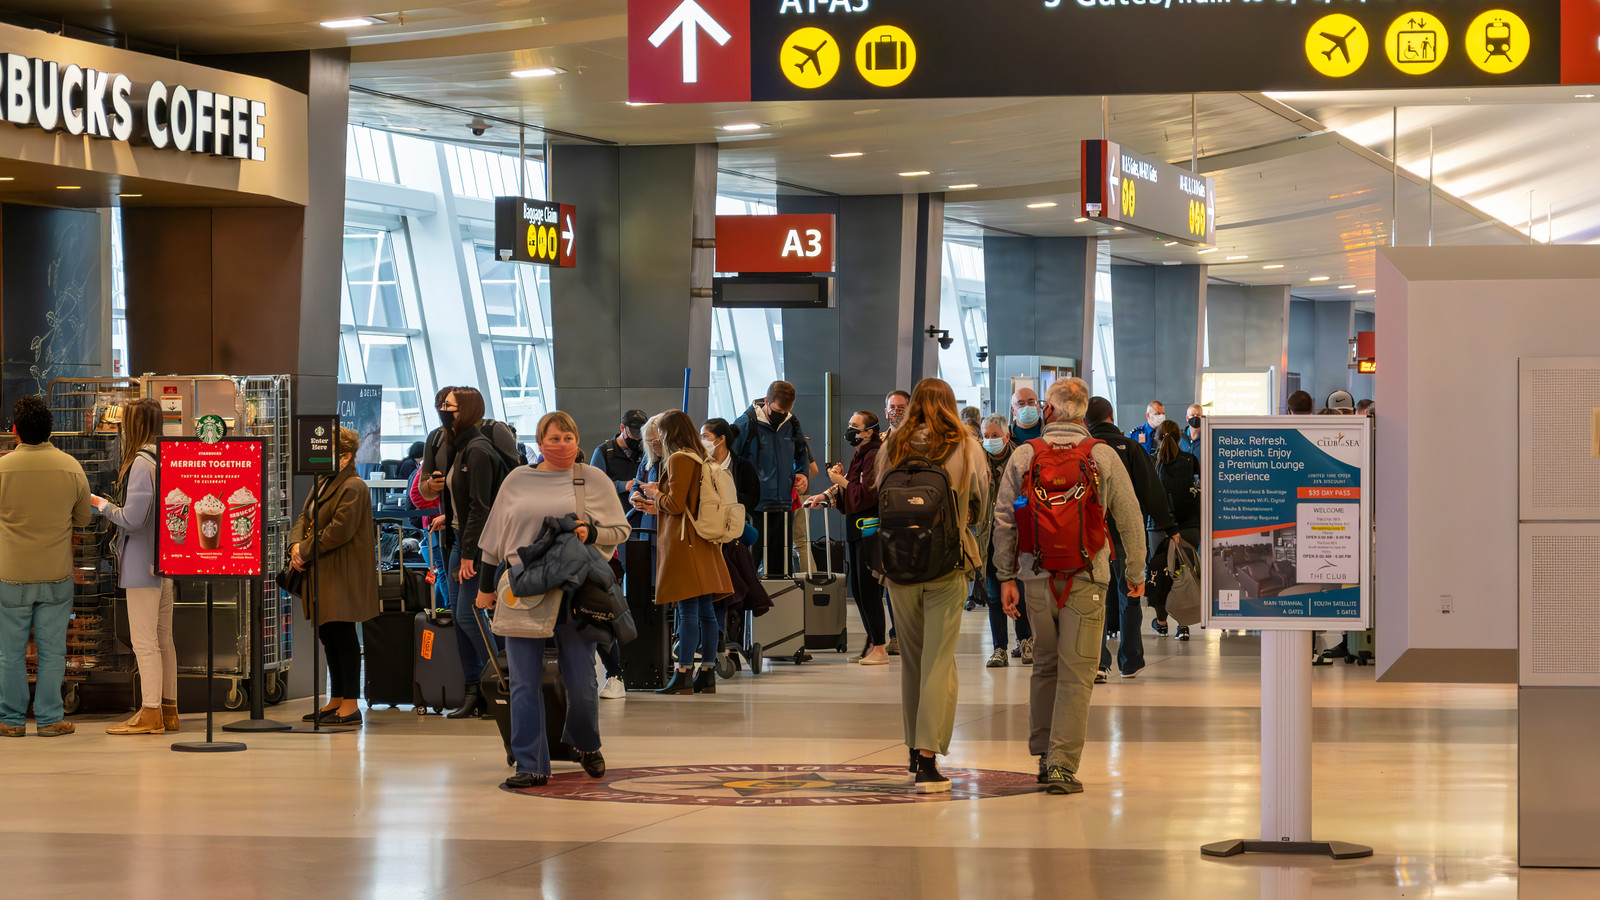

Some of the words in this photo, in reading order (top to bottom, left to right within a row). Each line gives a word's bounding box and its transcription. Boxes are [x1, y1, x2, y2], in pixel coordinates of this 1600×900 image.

[0, 53, 132, 141] BUCKS
[147, 80, 266, 161] COFFEE
[524, 202, 544, 225] Baggage
[544, 206, 558, 224] Claim
[781, 229, 822, 257] A3
[341, 400, 356, 416] CAN
[1218, 436, 1246, 445] Relax.
[1249, 436, 1287, 445] Refresh.
[1218, 448, 1265, 459] Replenish.
[1268, 448, 1291, 459] Enjoy
[1227, 460, 1268, 469] Premium
[1271, 460, 1304, 471] Lounge
[1218, 472, 1270, 483] Experience
